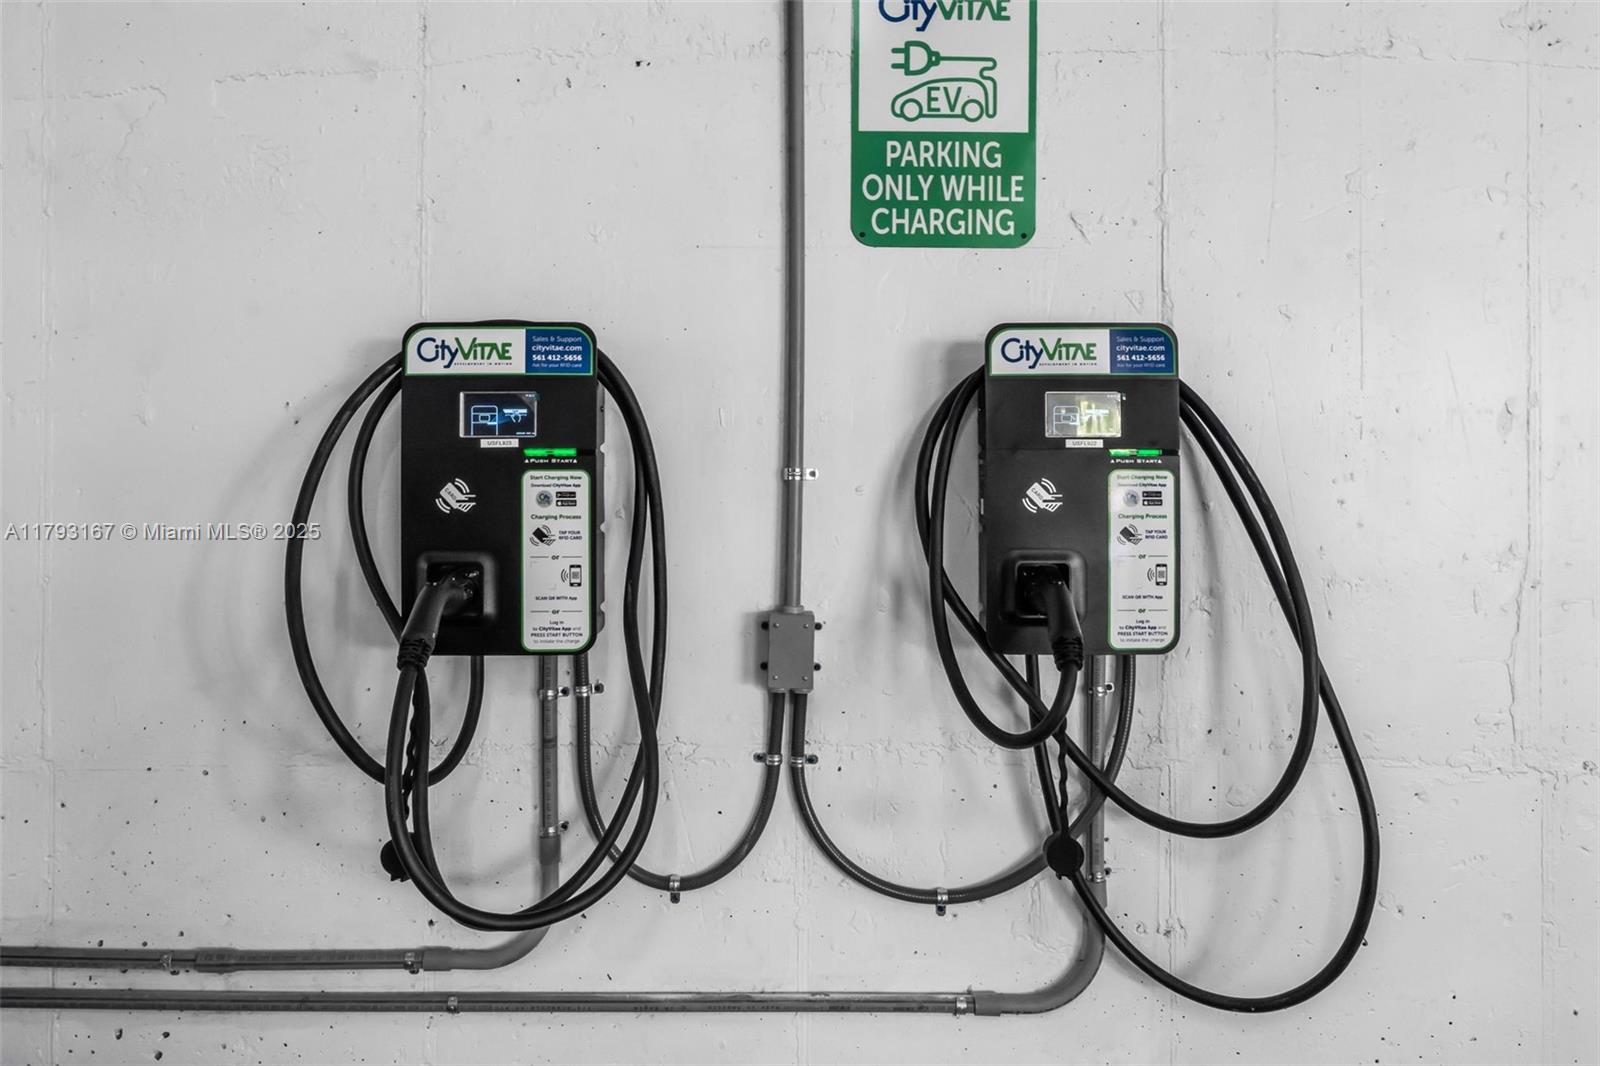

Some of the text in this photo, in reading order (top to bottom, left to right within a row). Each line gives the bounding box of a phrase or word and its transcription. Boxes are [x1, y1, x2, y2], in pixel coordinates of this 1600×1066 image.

[927, 86, 962, 112] EV
[886, 140, 1002, 168] PARKING
[862, 174, 1024, 202] ONLY WHILE
[871, 207, 1015, 235] CHARGING
[1116, 345, 1166, 353] cityvitae.com
